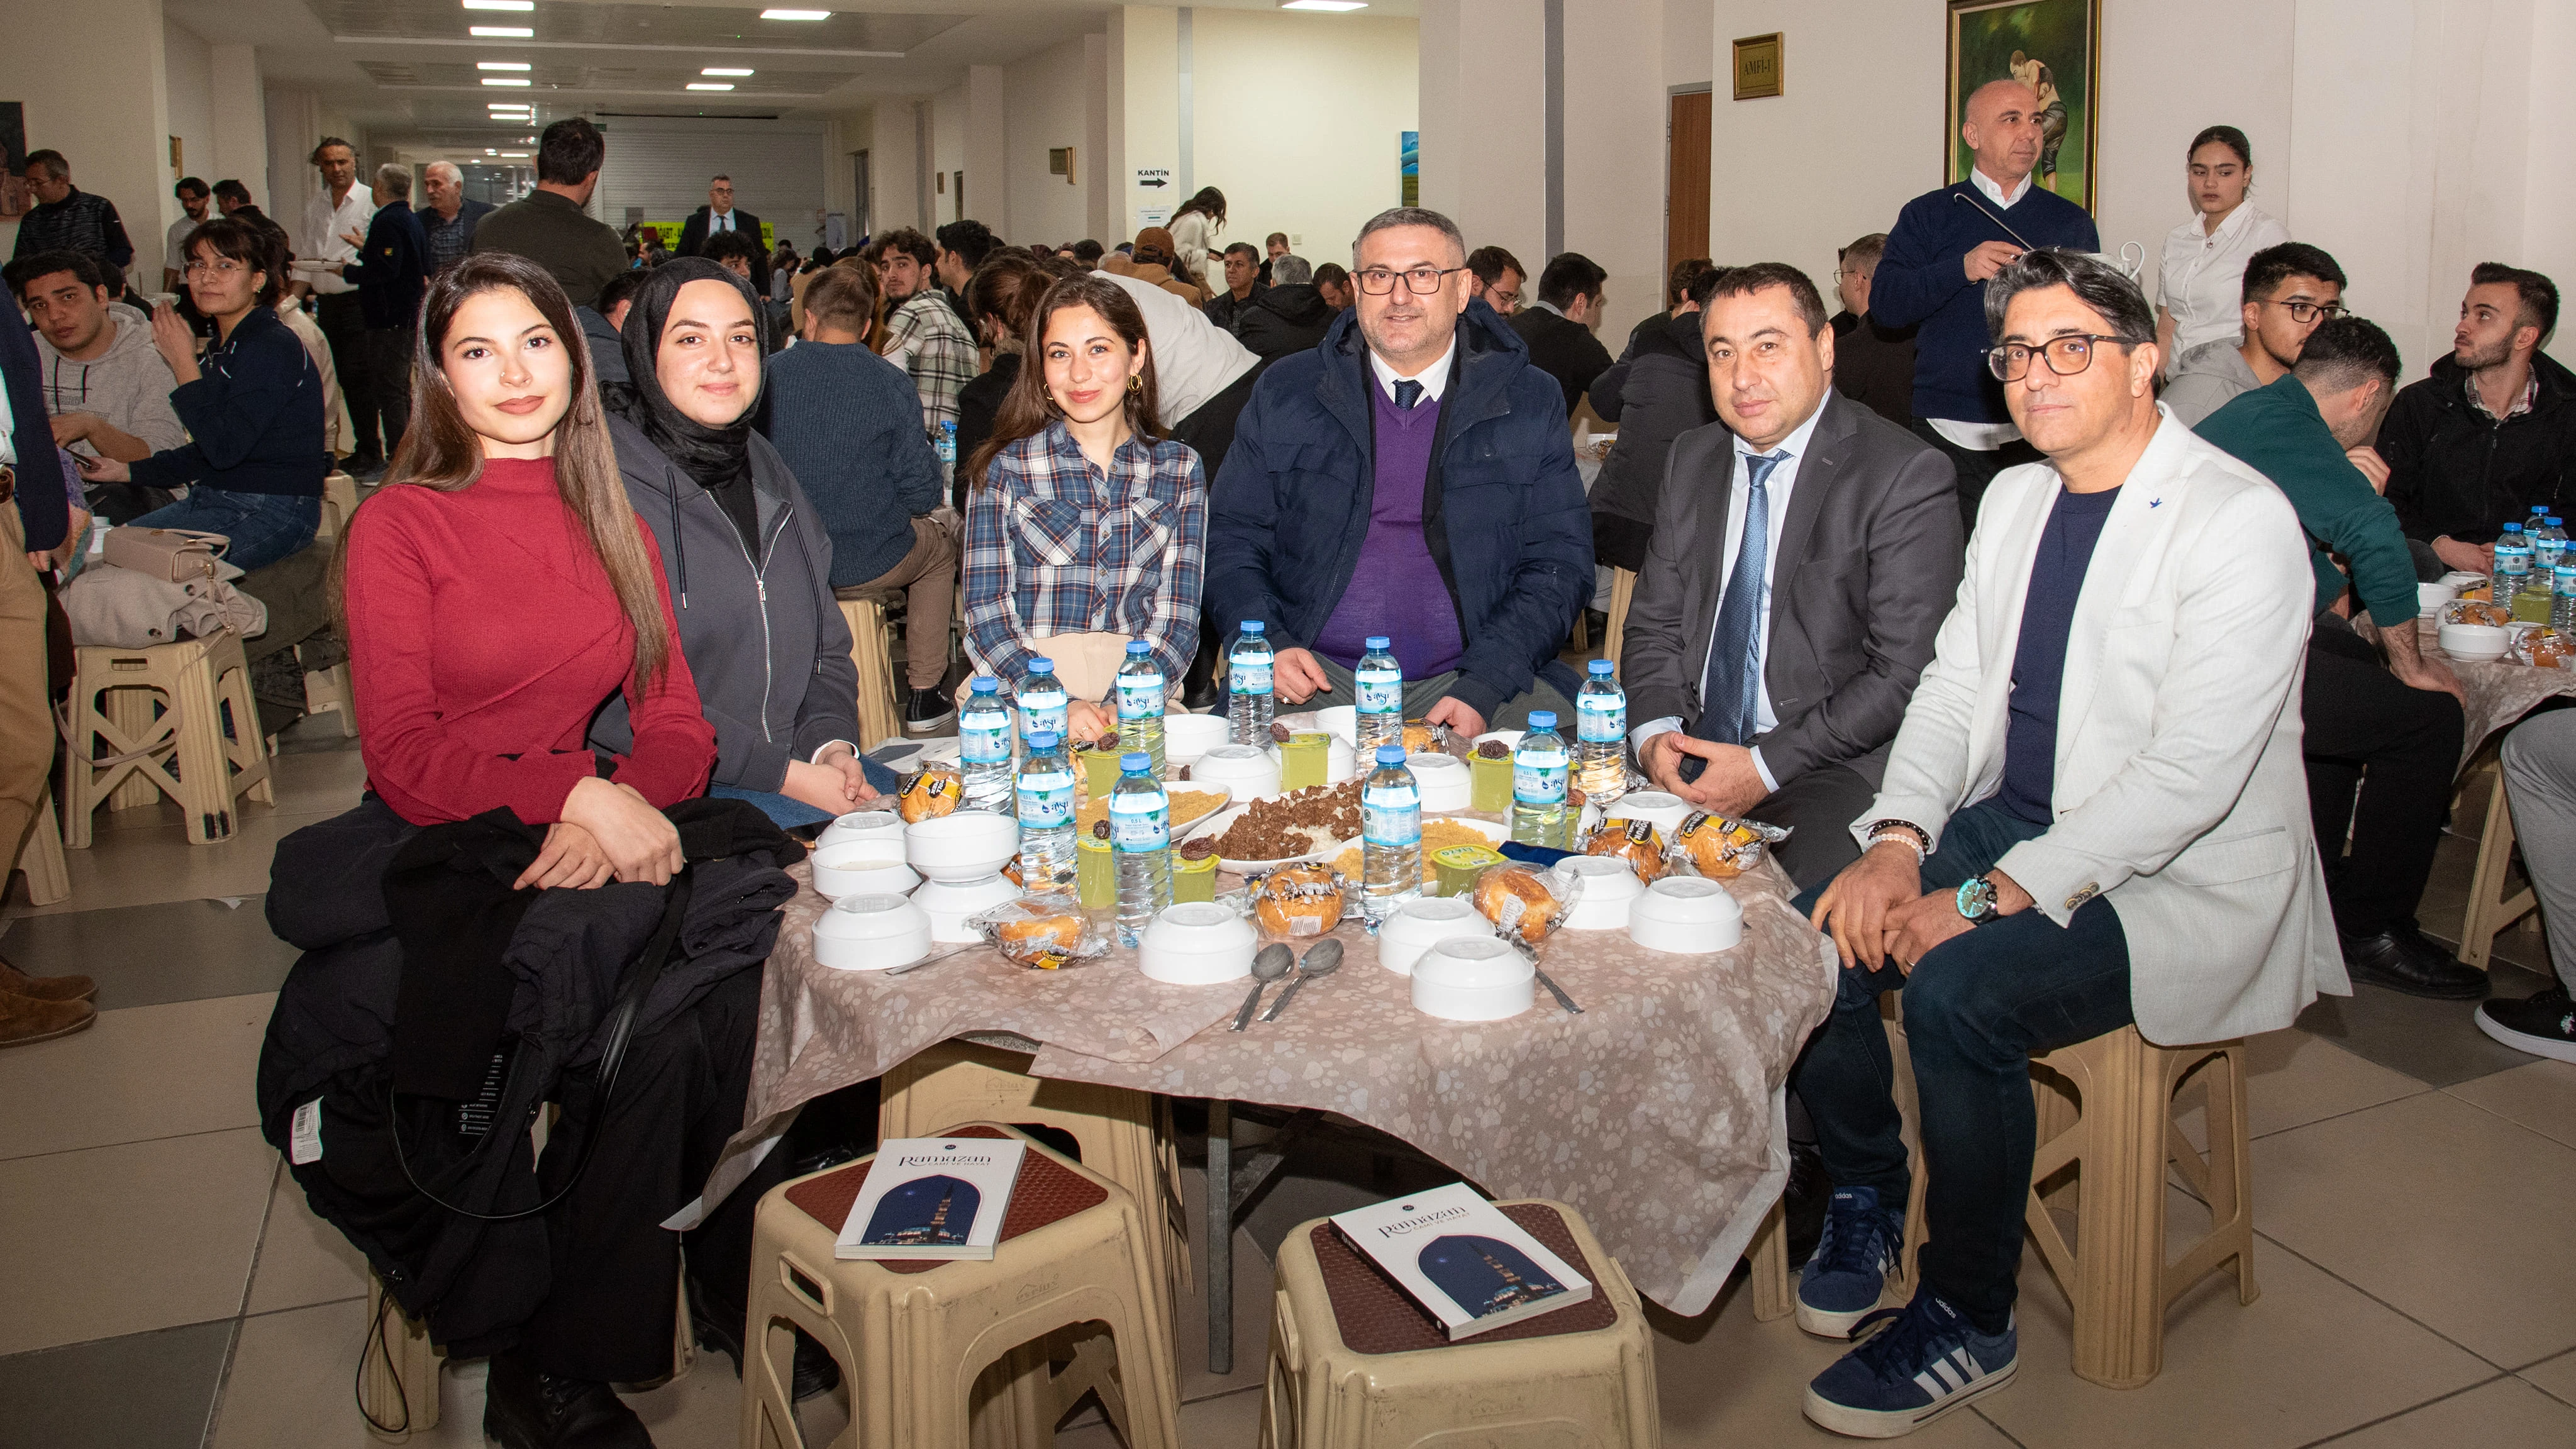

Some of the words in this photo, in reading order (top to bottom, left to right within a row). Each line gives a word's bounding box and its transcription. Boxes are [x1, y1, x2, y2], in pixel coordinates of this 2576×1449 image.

[899, 1156, 991, 1166] Ramazan
[1379, 1206, 1466, 1238] Ramazan
[1936, 1298, 1957, 1319] adidas
